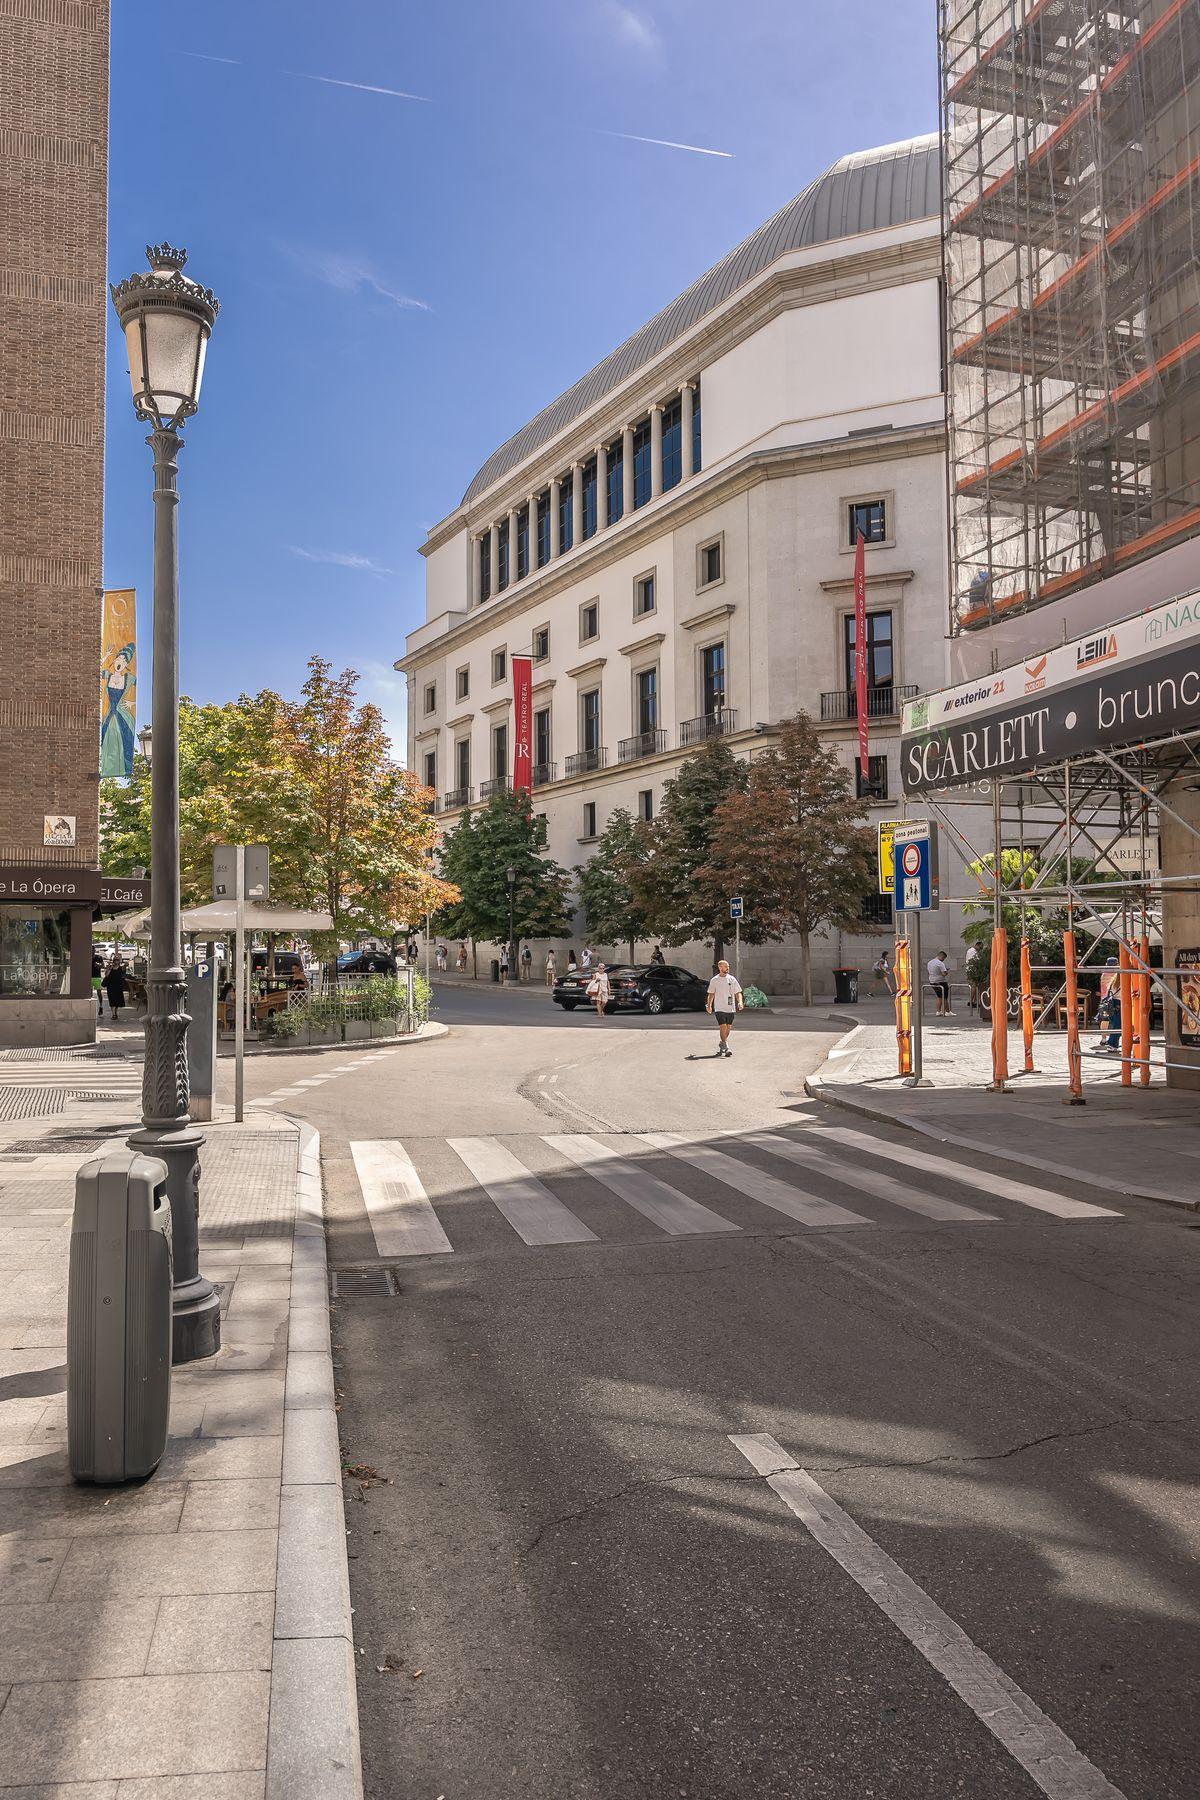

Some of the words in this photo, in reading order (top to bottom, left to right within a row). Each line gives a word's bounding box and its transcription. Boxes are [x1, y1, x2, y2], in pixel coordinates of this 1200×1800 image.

[954, 687, 992, 708] exterior
[992, 680, 1005, 695] 21
[907, 707, 1050, 786] SCARLETT
[1098, 670, 1200, 729] brunc
[907, 826, 928, 837] peatonal
[11, 880, 28, 893] La
[33, 877, 76, 895] Ópera
[113, 885, 143, 900] Café
[3, 969, 18, 980] La
[197, 963, 209, 978] P
